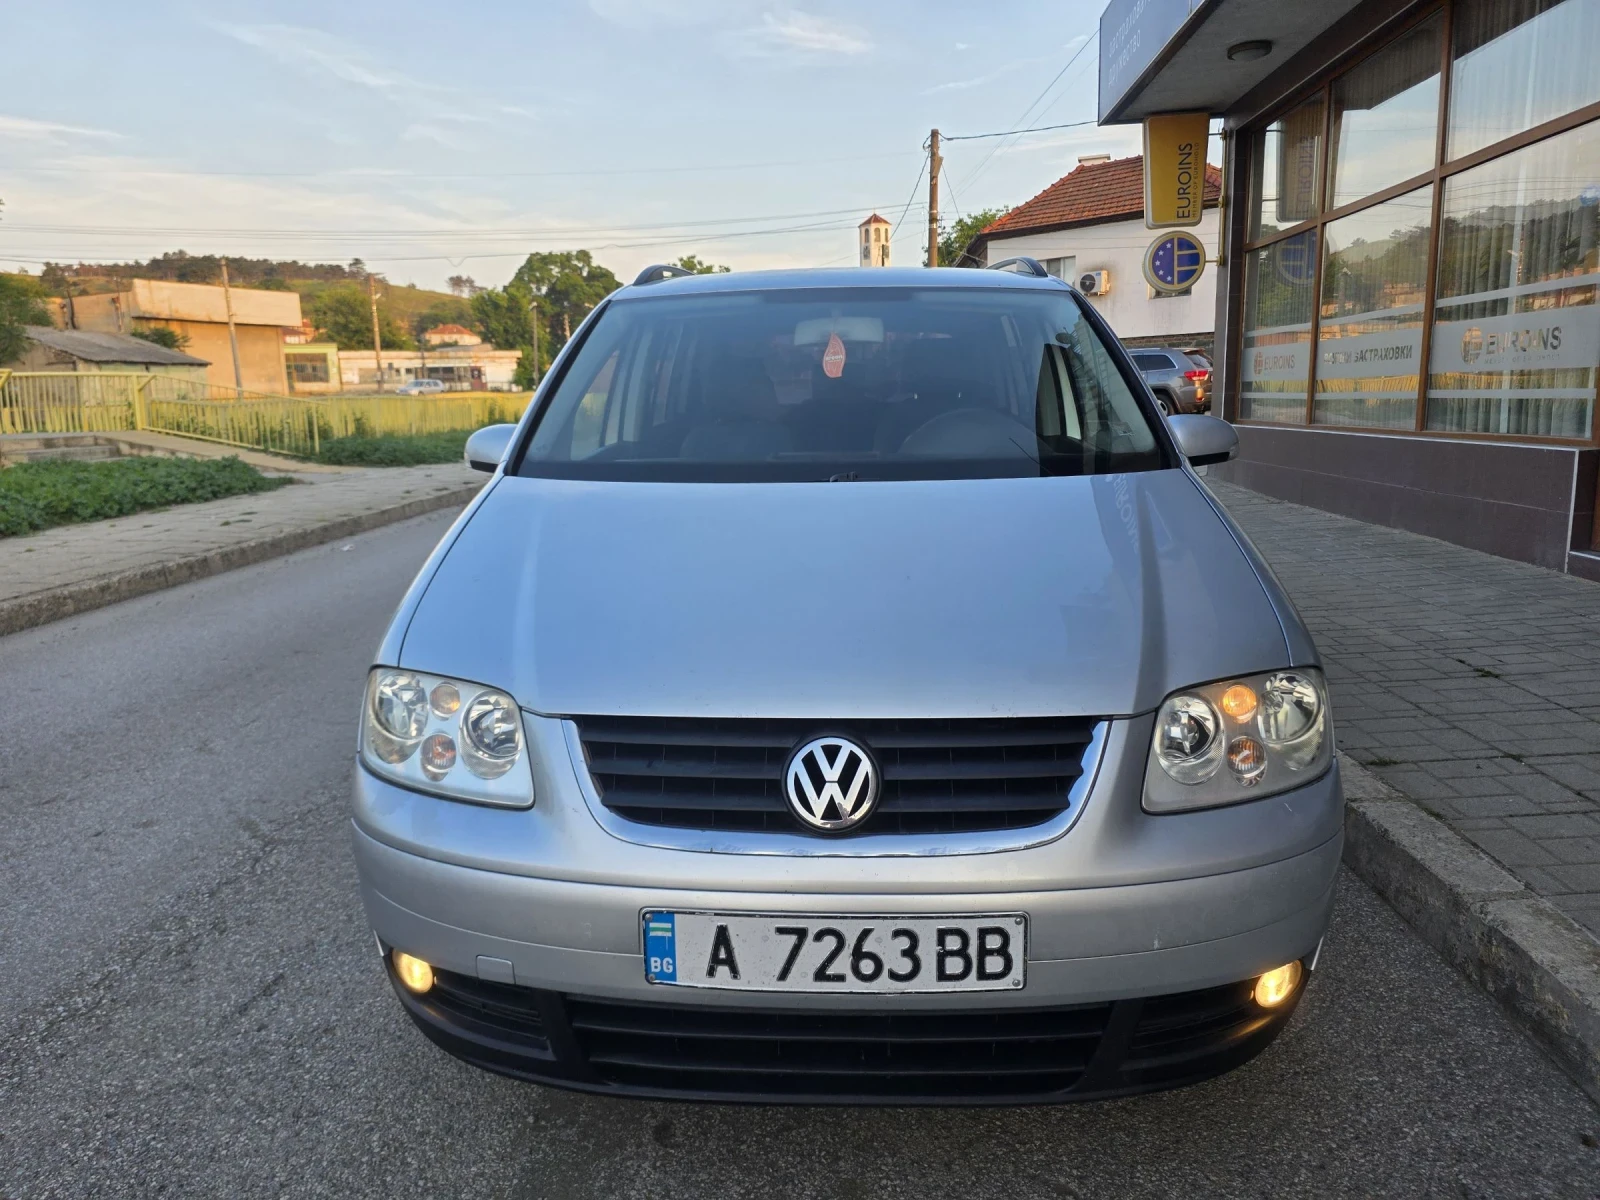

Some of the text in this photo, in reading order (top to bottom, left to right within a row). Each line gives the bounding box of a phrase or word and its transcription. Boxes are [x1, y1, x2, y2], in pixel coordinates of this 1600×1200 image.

[1177, 143, 1193, 219] EUROINS
[1193, 181, 1199, 190] OF
[1486, 326, 1562, 354] EUROINS
[1264, 354, 1296, 371] EUROINS
[1354, 345, 1413, 363] ЗАСТРАХОВКИ
[705, 923, 741, 980] A
[651, 957, 673, 973] BG
